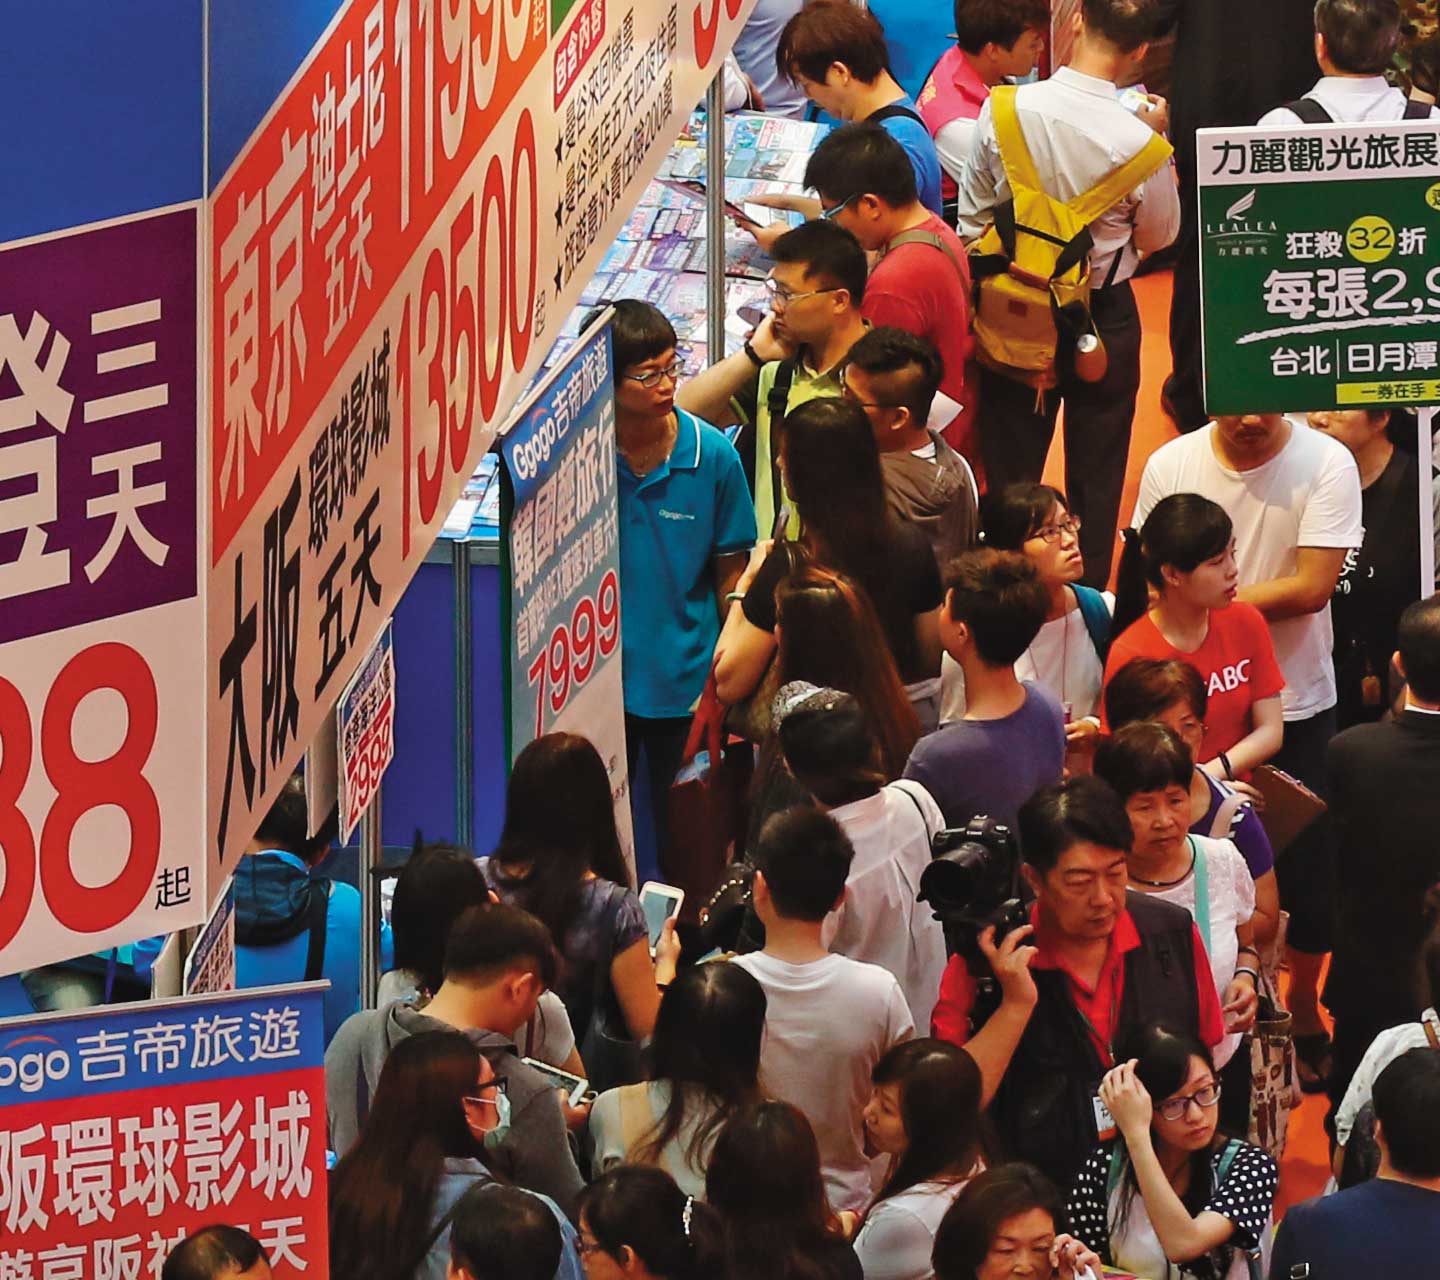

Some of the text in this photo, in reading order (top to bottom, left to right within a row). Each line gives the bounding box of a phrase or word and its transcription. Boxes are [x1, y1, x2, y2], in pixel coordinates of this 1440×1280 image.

[214, 125, 309, 507] 東京
[395, 103, 539, 562] 13500
[1270, 345, 1331, 376] 台北
[1347, 340, 1439, 374] 日月潭
[1360, 383, 1426, 401] 一券在手
[80, 302, 173, 587] 三天
[217, 464, 304, 820] 大阪
[527, 566, 620, 738] 7999
[153, 865, 194, 909] 起
[75, 1003, 302, 1084] 吉帝旅遊
